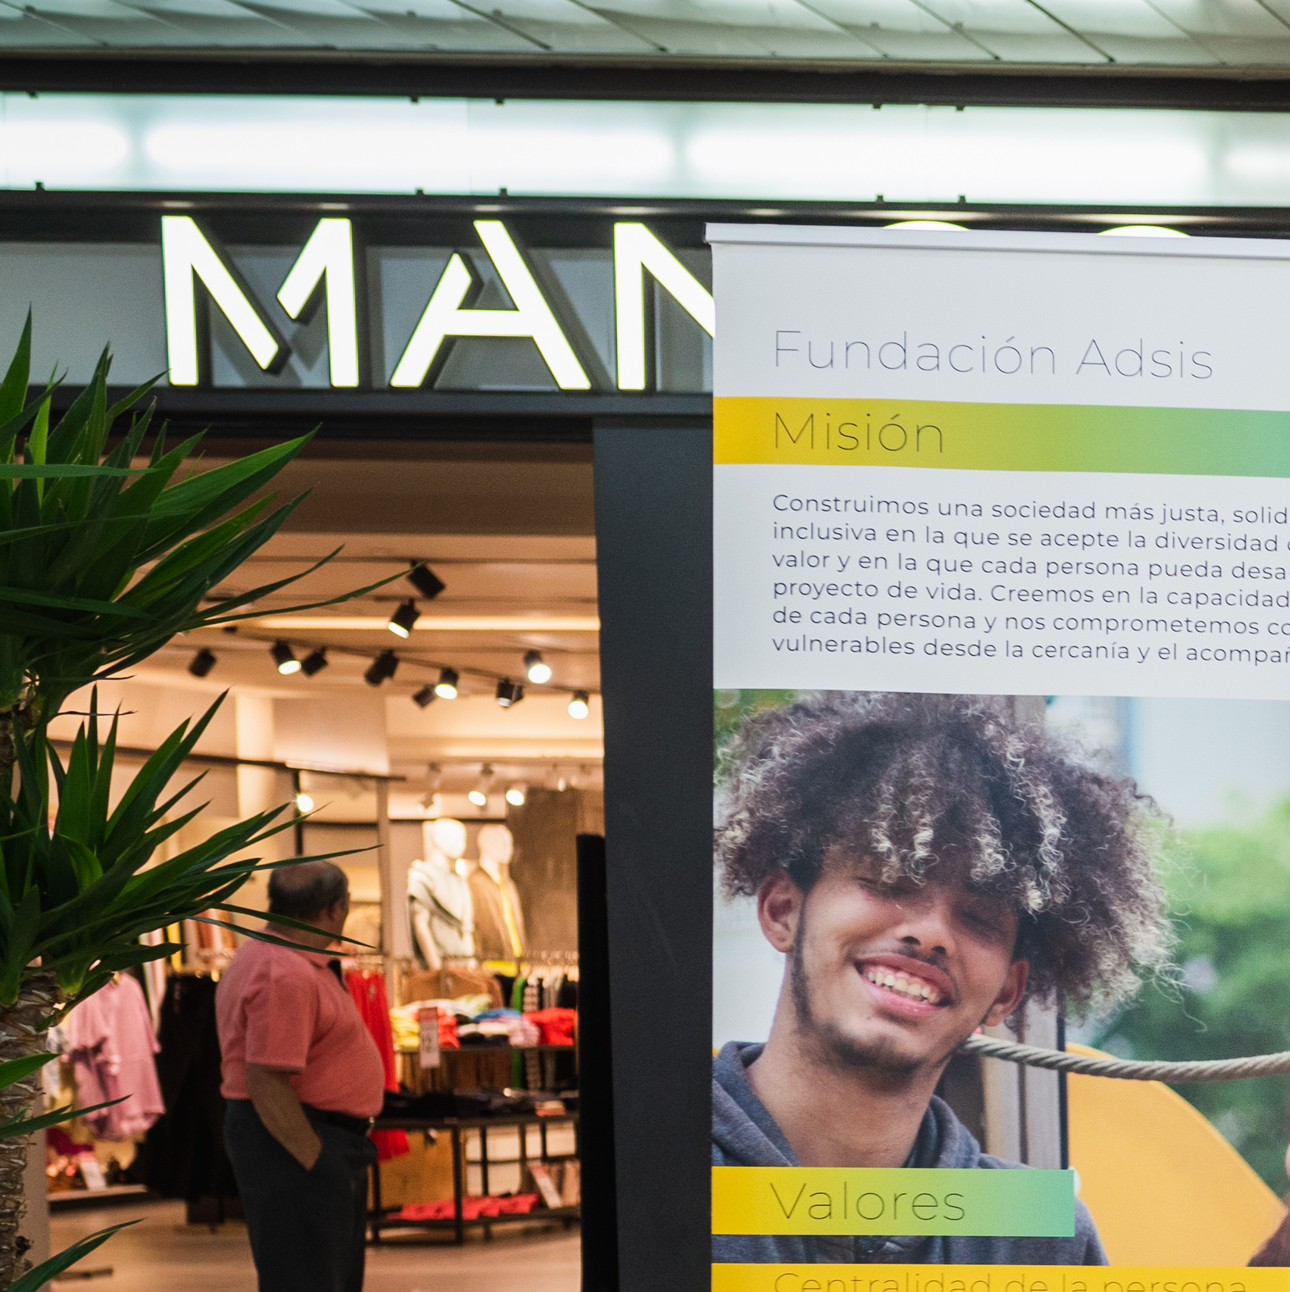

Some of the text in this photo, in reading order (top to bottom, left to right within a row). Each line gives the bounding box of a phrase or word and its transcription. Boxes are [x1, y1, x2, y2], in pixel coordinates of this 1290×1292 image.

[774, 329, 1215, 380] Fundación Adsis
[773, 410, 945, 455] Misión
[772, 493, 930, 516] Construimos
[937, 502, 983, 518] una
[991, 500, 1096, 520] sociedad
[1105, 502, 1154, 521] más
[1159, 503, 1225, 526] justa,
[773, 521, 877, 542] inclusiva
[885, 528, 916, 543] en
[925, 525, 945, 545] la
[953, 530, 1001, 549] que
[1007, 532, 1033, 547] se
[1040, 531, 1120, 551] acepte
[1128, 530, 1147, 549] la
[1154, 531, 1278, 553] diversidad
[771, 549, 831, 569] valor
[836, 555, 851, 574] y
[857, 555, 888, 570] en
[898, 552, 918, 572] la
[925, 557, 974, 576] que
[980, 556, 1037, 575] cada
[1046, 560, 1139, 579] persona
[1148, 560, 1223, 581] pueda
[773, 581, 879, 601] proyecto
[886, 580, 919, 600] de
[925, 582, 983, 602] vida.
[990, 584, 1095, 604] Creemos
[1101, 589, 1131, 604] en
[1139, 586, 1158, 605] la
[1166, 588, 1290, 610] capacidad
[772, 605, 803, 625] de
[809, 606, 868, 626] cada
[877, 612, 976, 630] persona
[983, 616, 997, 634] y
[1005, 616, 1046, 631] nos
[1052, 616, 1260, 635] comprometemos
[771, 634, 916, 656] vulnerables
[922, 637, 997, 658] desde
[1005, 639, 1024, 659] la
[1031, 641, 1130, 660] cercanía
[1136, 646, 1151, 665] y
[1157, 642, 1177, 661] el
[769, 1180, 968, 1222] Valores
